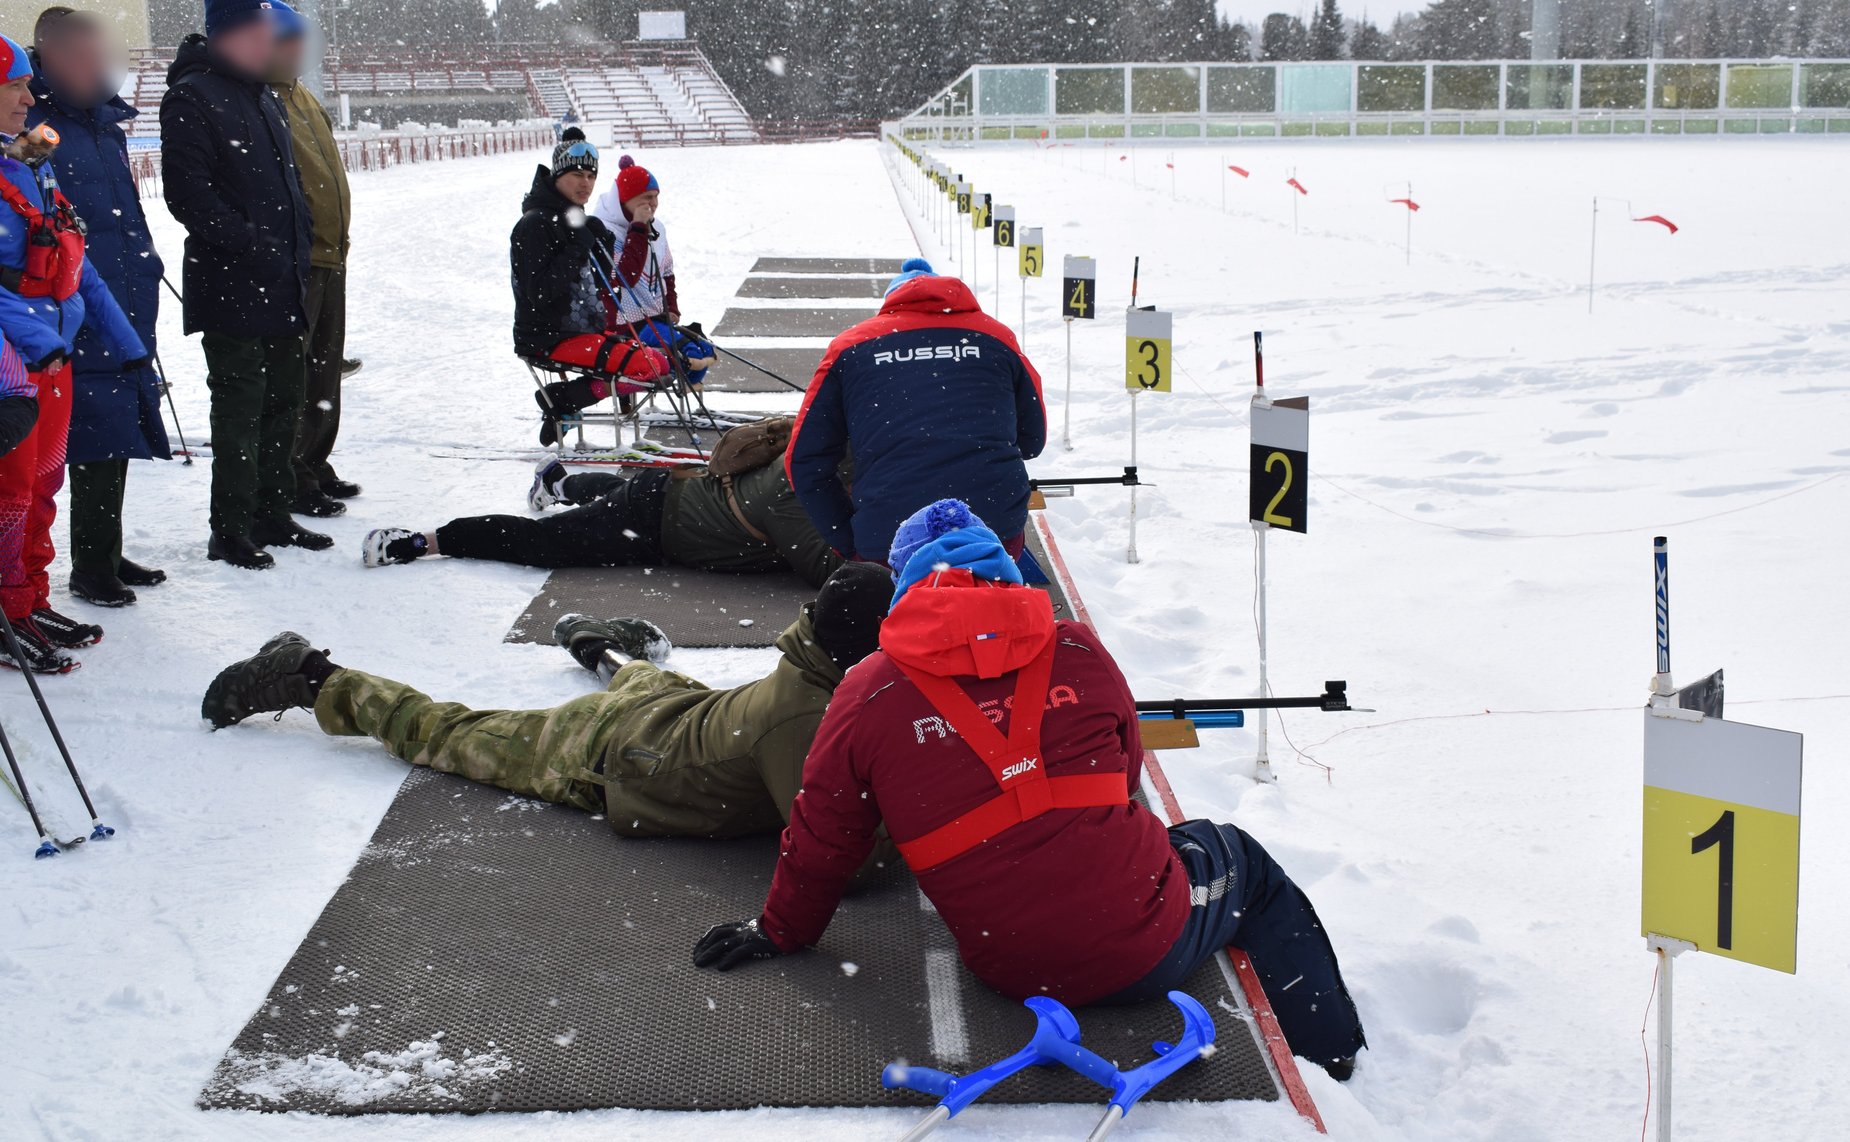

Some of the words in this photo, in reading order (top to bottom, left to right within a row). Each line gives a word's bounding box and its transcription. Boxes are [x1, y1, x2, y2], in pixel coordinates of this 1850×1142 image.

[949, 184, 957, 201] 9
[960, 194, 968, 213] 8
[975, 206, 982, 228] 7
[998, 221, 1010, 246] 6
[1025, 246, 1037, 276] 5
[1069, 280, 1088, 317] 4
[873, 345, 981, 366] RUSSIA
[1138, 340, 1161, 389] 3
[1263, 451, 1293, 527] 2
[1691, 810, 1735, 950] 1
